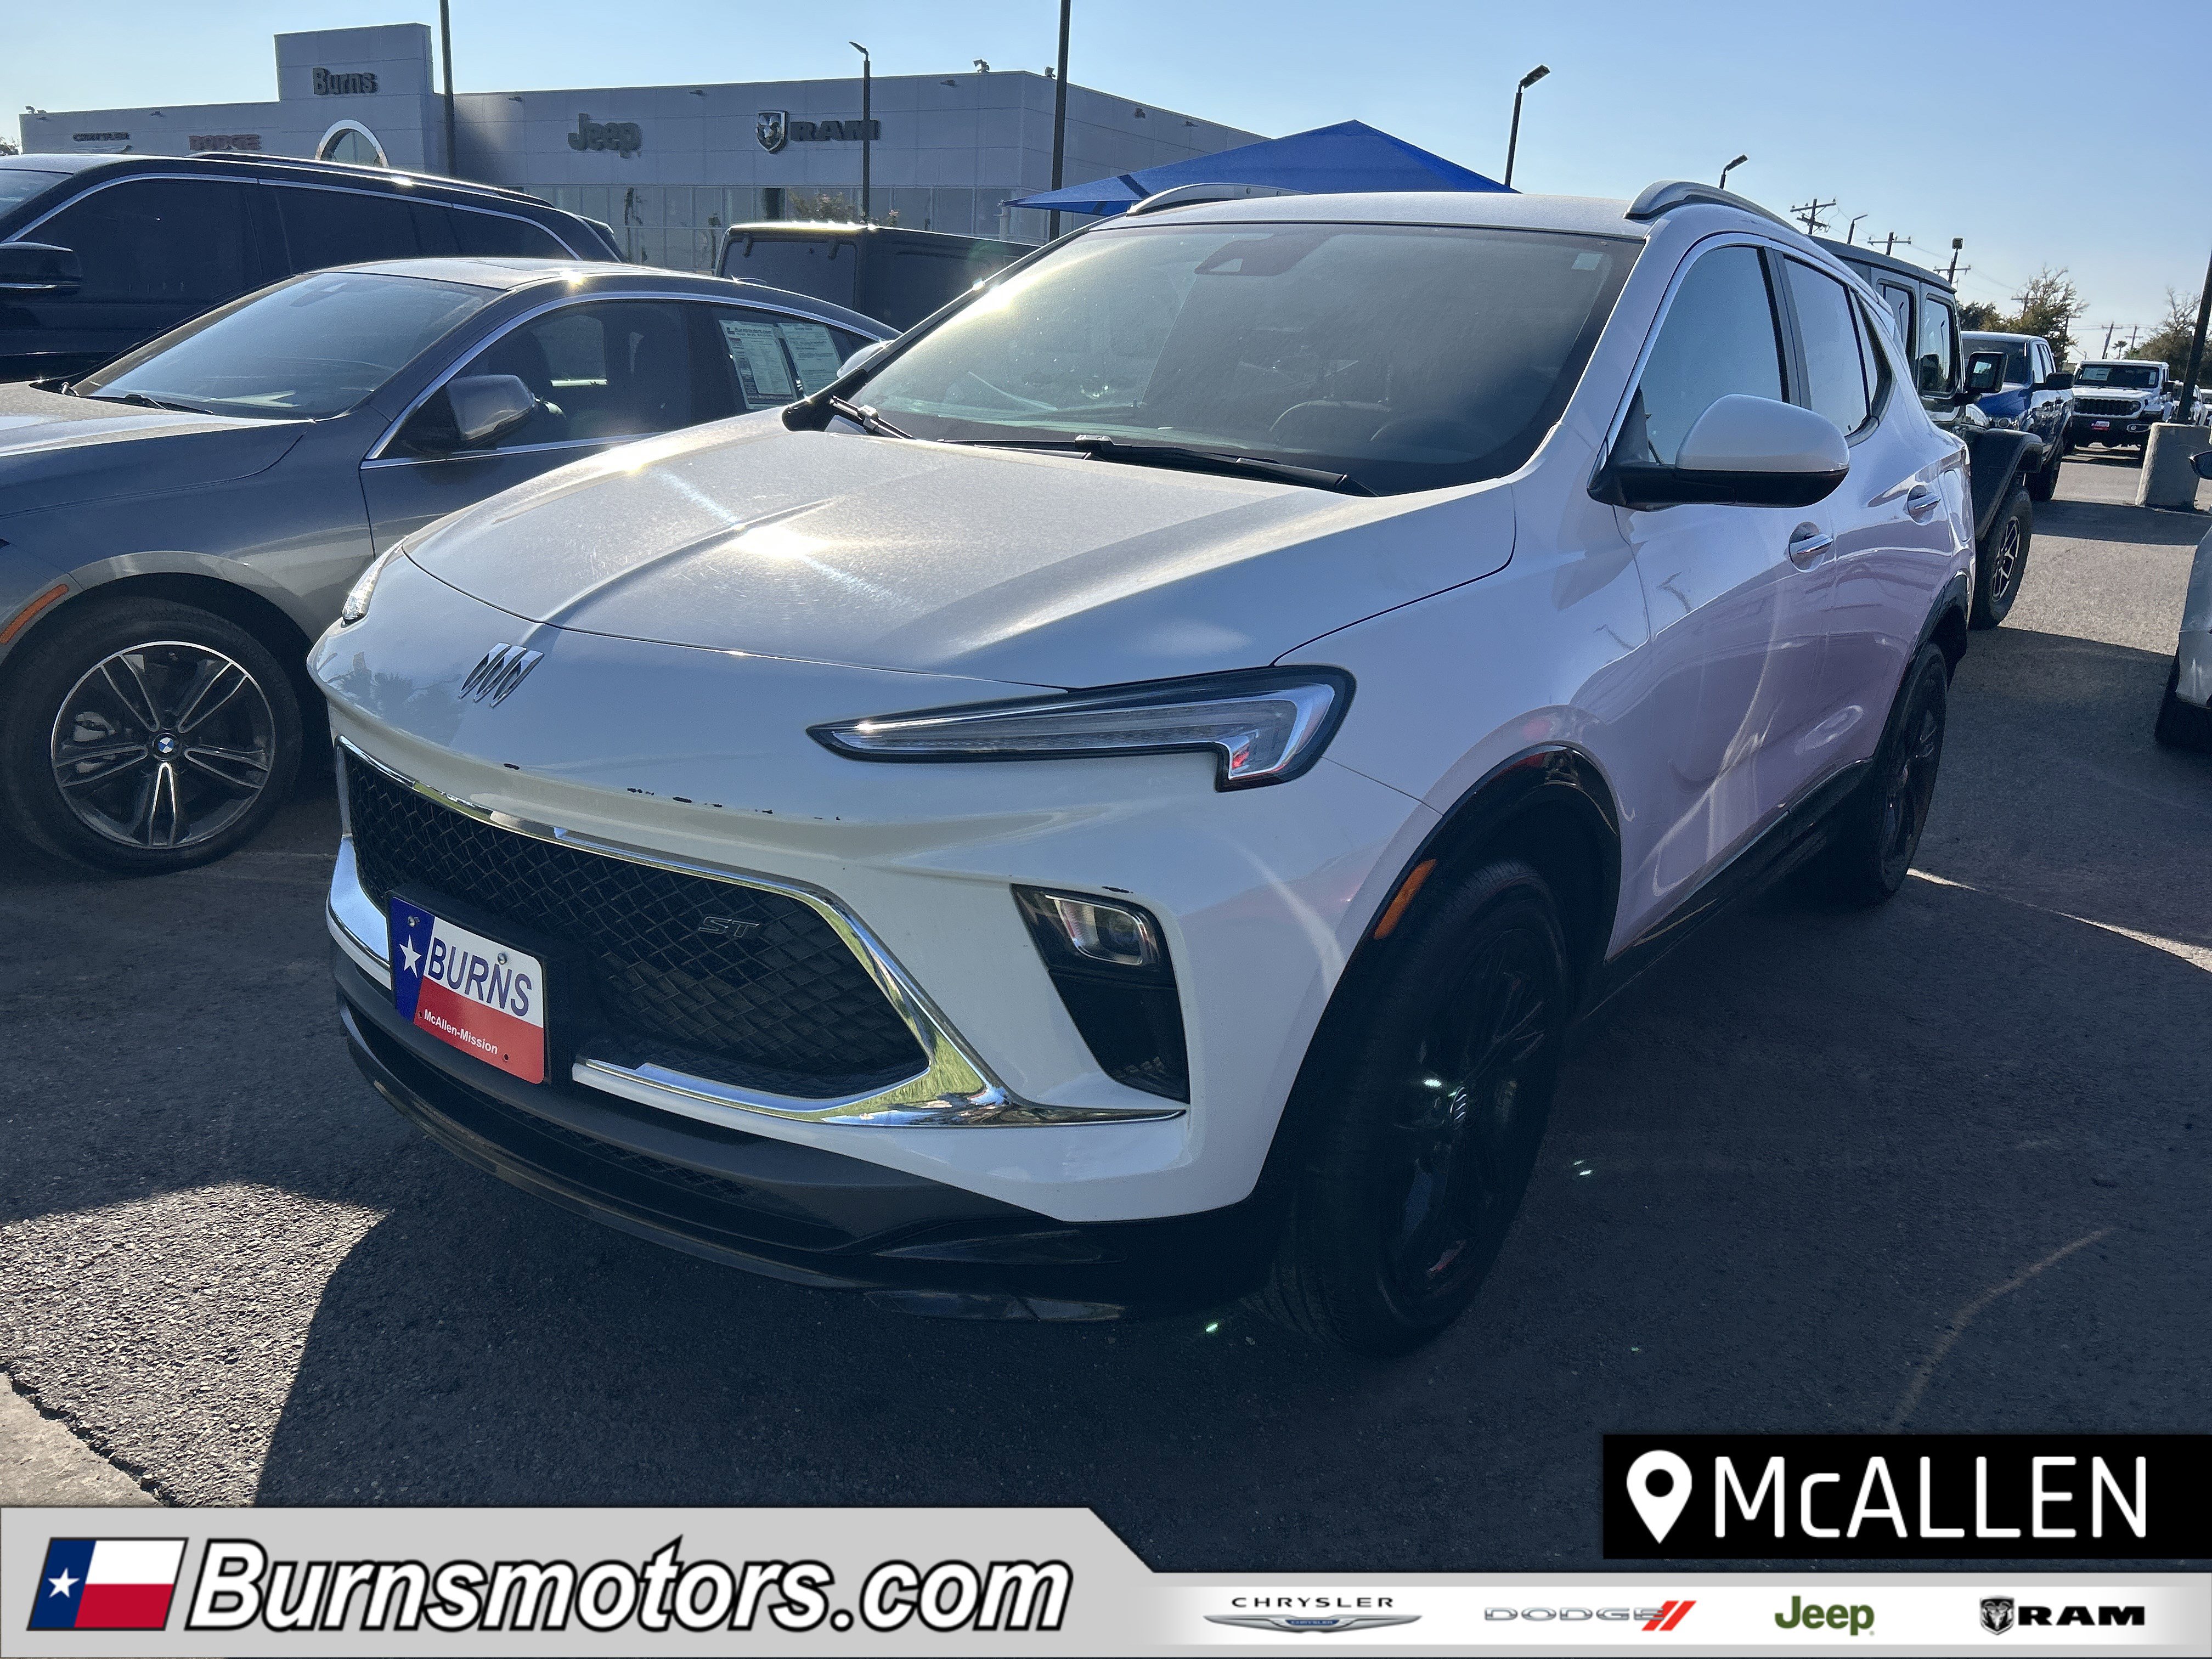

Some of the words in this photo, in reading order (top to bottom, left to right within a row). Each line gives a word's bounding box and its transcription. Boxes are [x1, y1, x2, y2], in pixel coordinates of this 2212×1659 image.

[313, 67, 377, 95] Burns
[568, 113, 640, 159] Jeep
[791, 121, 880, 141] RAM
[698, 916, 760, 938] ST
[428, 937, 532, 1017] BURNS
[424, 1008, 498, 1055] McAllen-Mission
